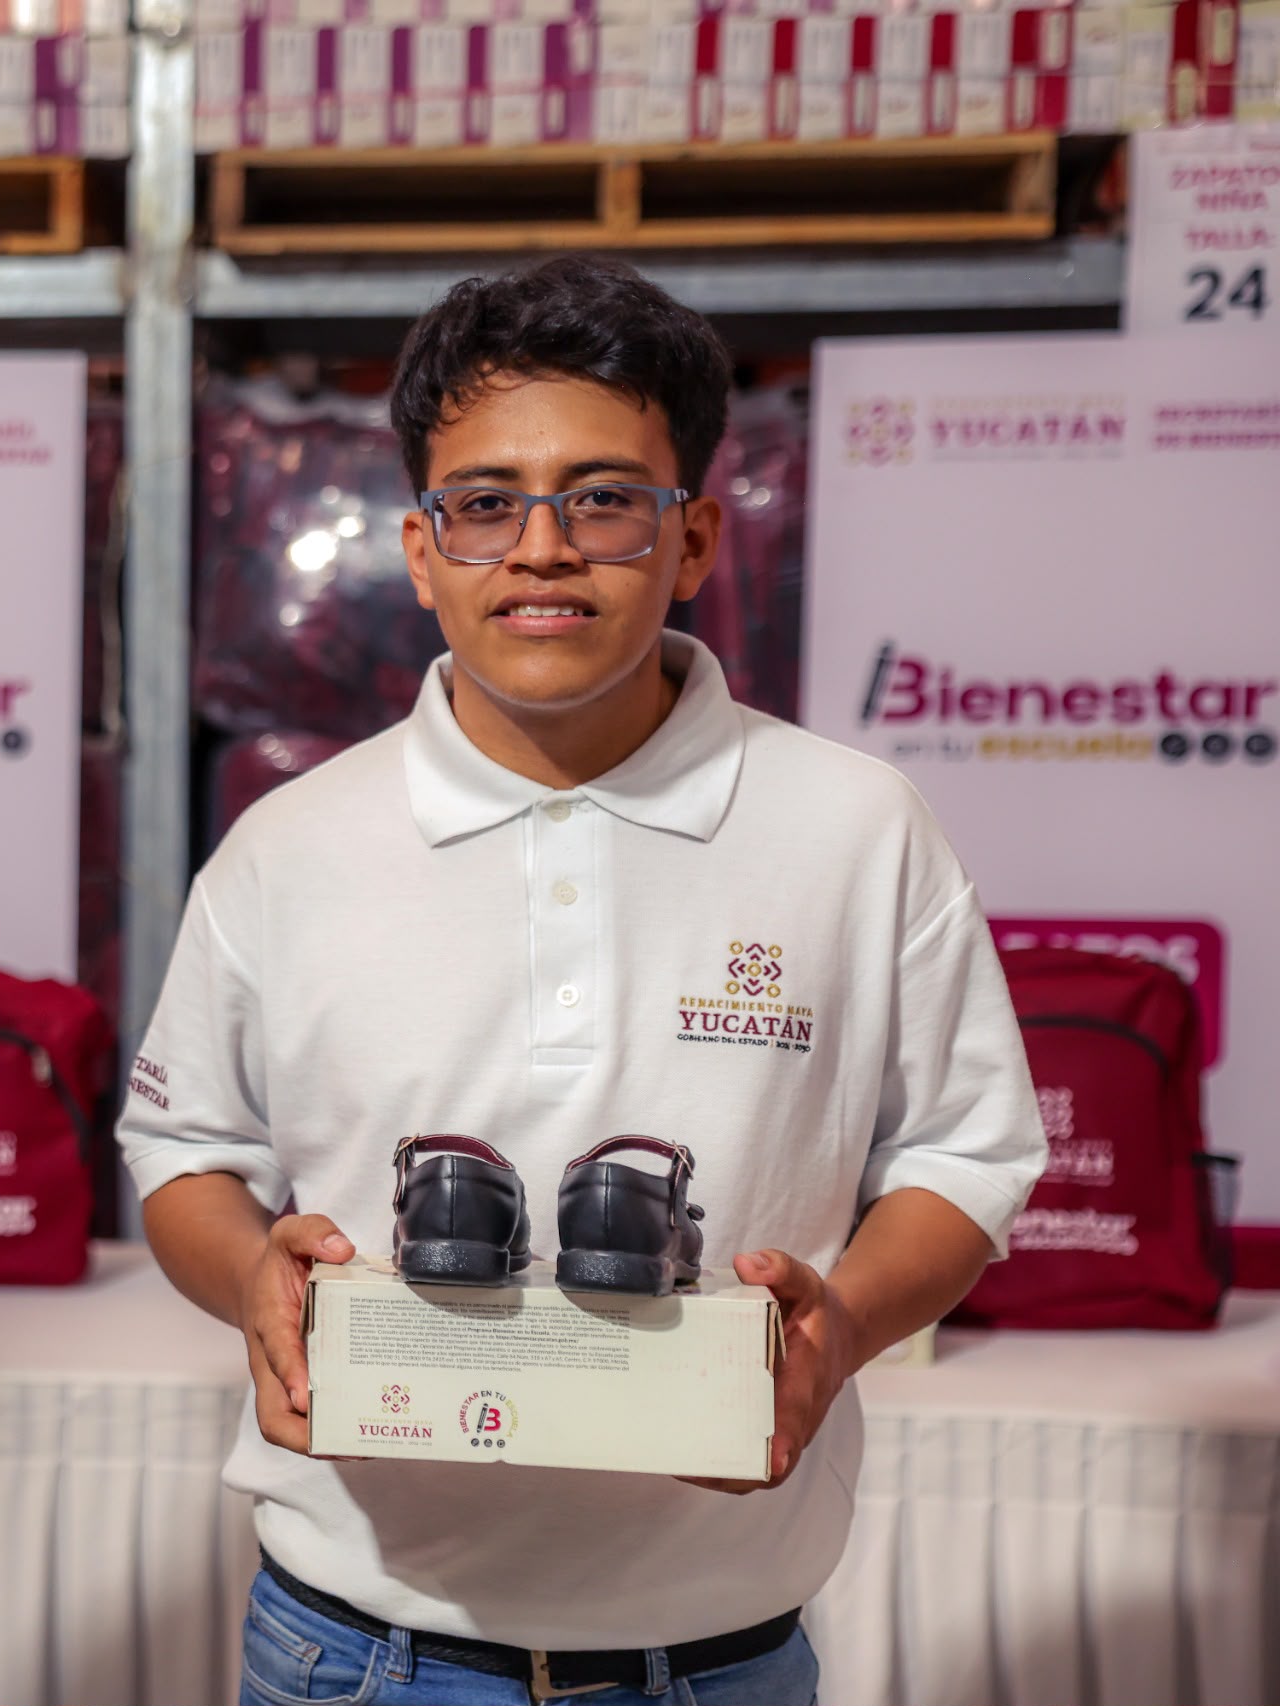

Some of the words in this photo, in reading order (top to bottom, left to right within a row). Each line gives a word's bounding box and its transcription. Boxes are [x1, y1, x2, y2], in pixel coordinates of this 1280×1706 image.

[1184, 264, 1269, 322] 24
[860, 640, 1279, 725] Bienestar
[679, 995, 783, 1013] RENACIMIENTO
[787, 1005, 814, 1018] MAYA
[678, 1010, 814, 1042] YUCATÁN
[721, 1036, 736, 1044] DEL
[738, 1038, 769, 1046] ESTADO
[480, 1390, 492, 1398] EN
[495, 1391, 507, 1401] TU
[358, 1424, 432, 1438] YUCATÁN
